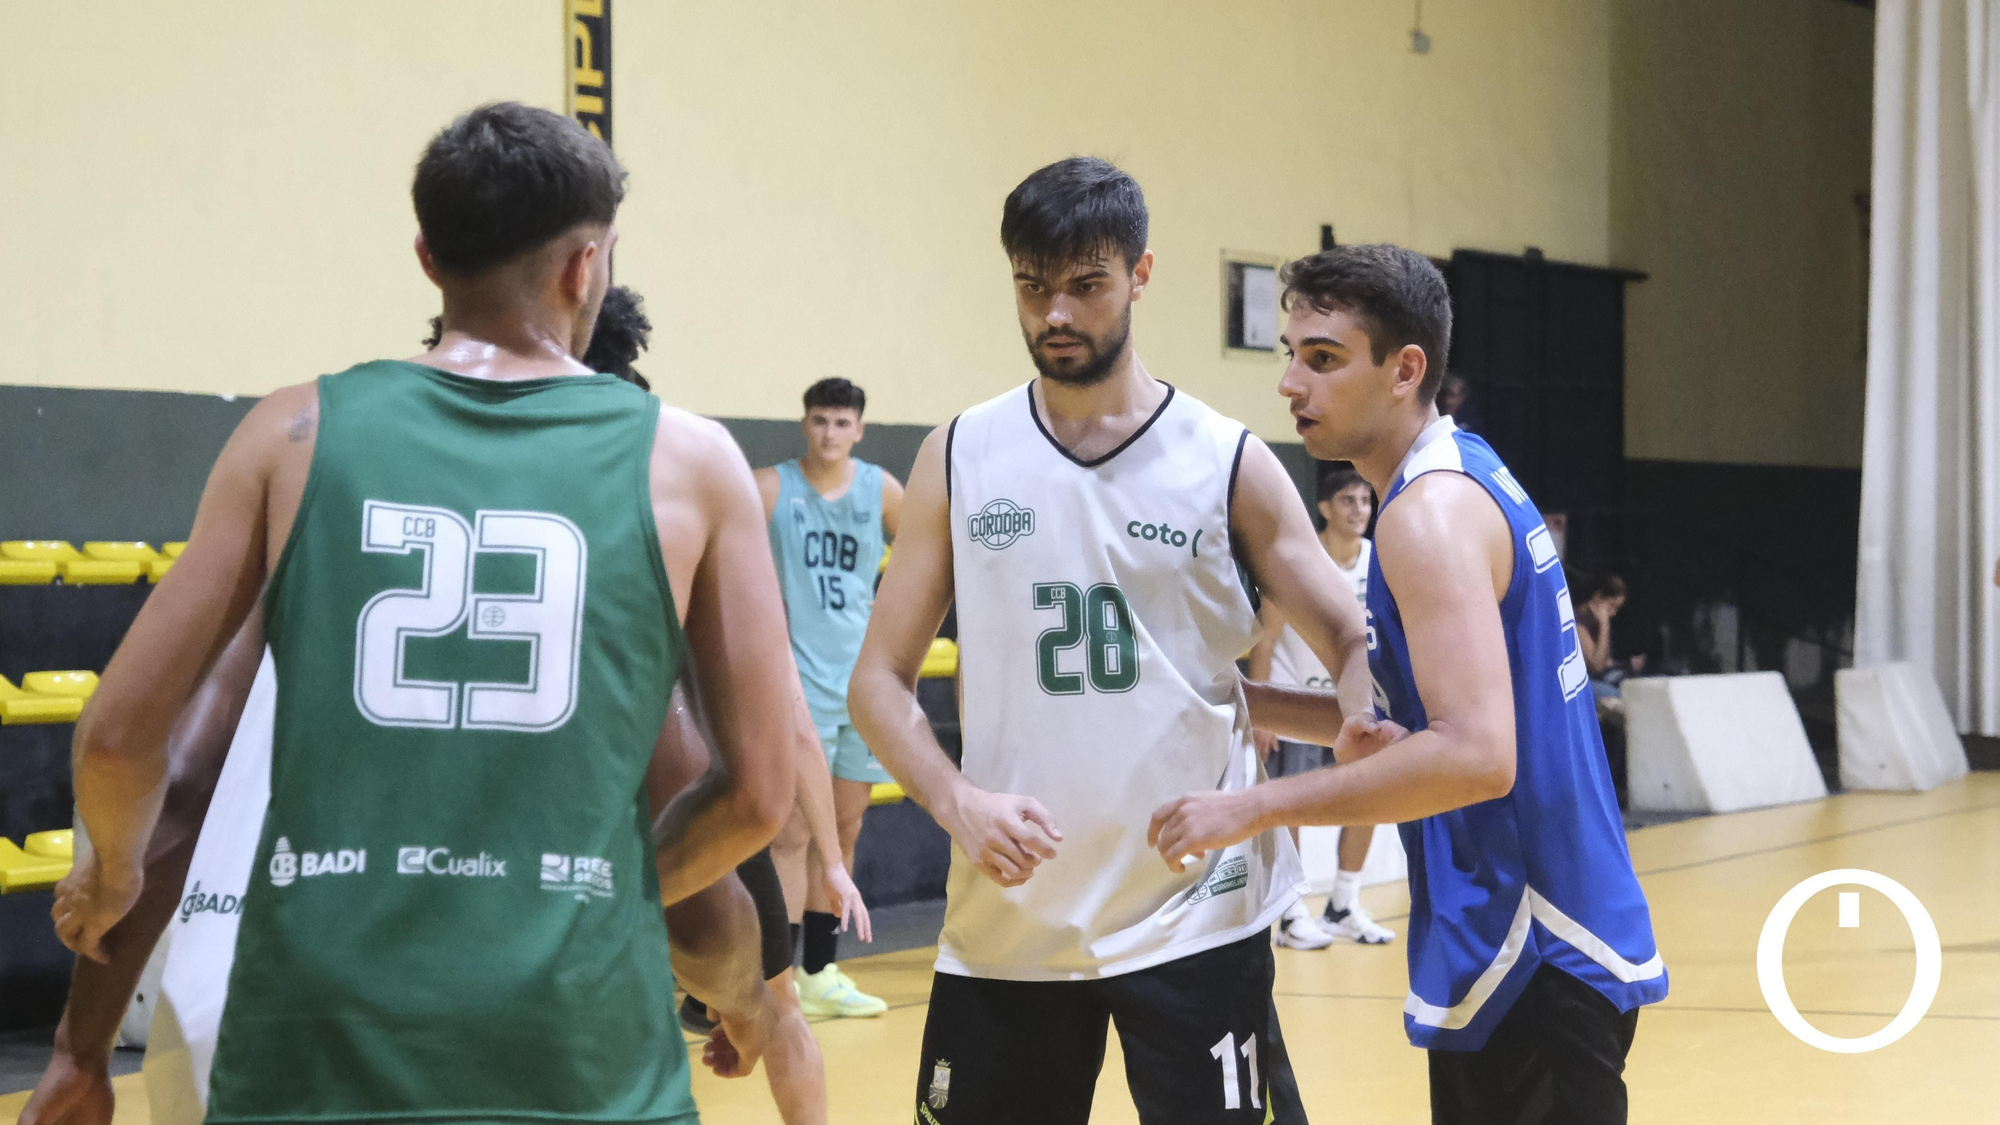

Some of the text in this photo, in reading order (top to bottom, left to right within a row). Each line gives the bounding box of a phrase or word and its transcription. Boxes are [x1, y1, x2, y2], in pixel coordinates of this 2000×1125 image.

[403, 516, 436, 537] CCB
[970, 511, 1031, 538] CORDOBA
[1127, 520, 1187, 548] coto
[804, 531, 858, 572] CDB
[818, 575, 845, 611] 15
[1051, 587, 1066, 600] CCB
[354, 499, 588, 733] 23
[1032, 581, 1140, 696] 28
[300, 849, 368, 877] BADI
[426, 847, 507, 877] Cualix
[1210, 1032, 1262, 1109] 11
